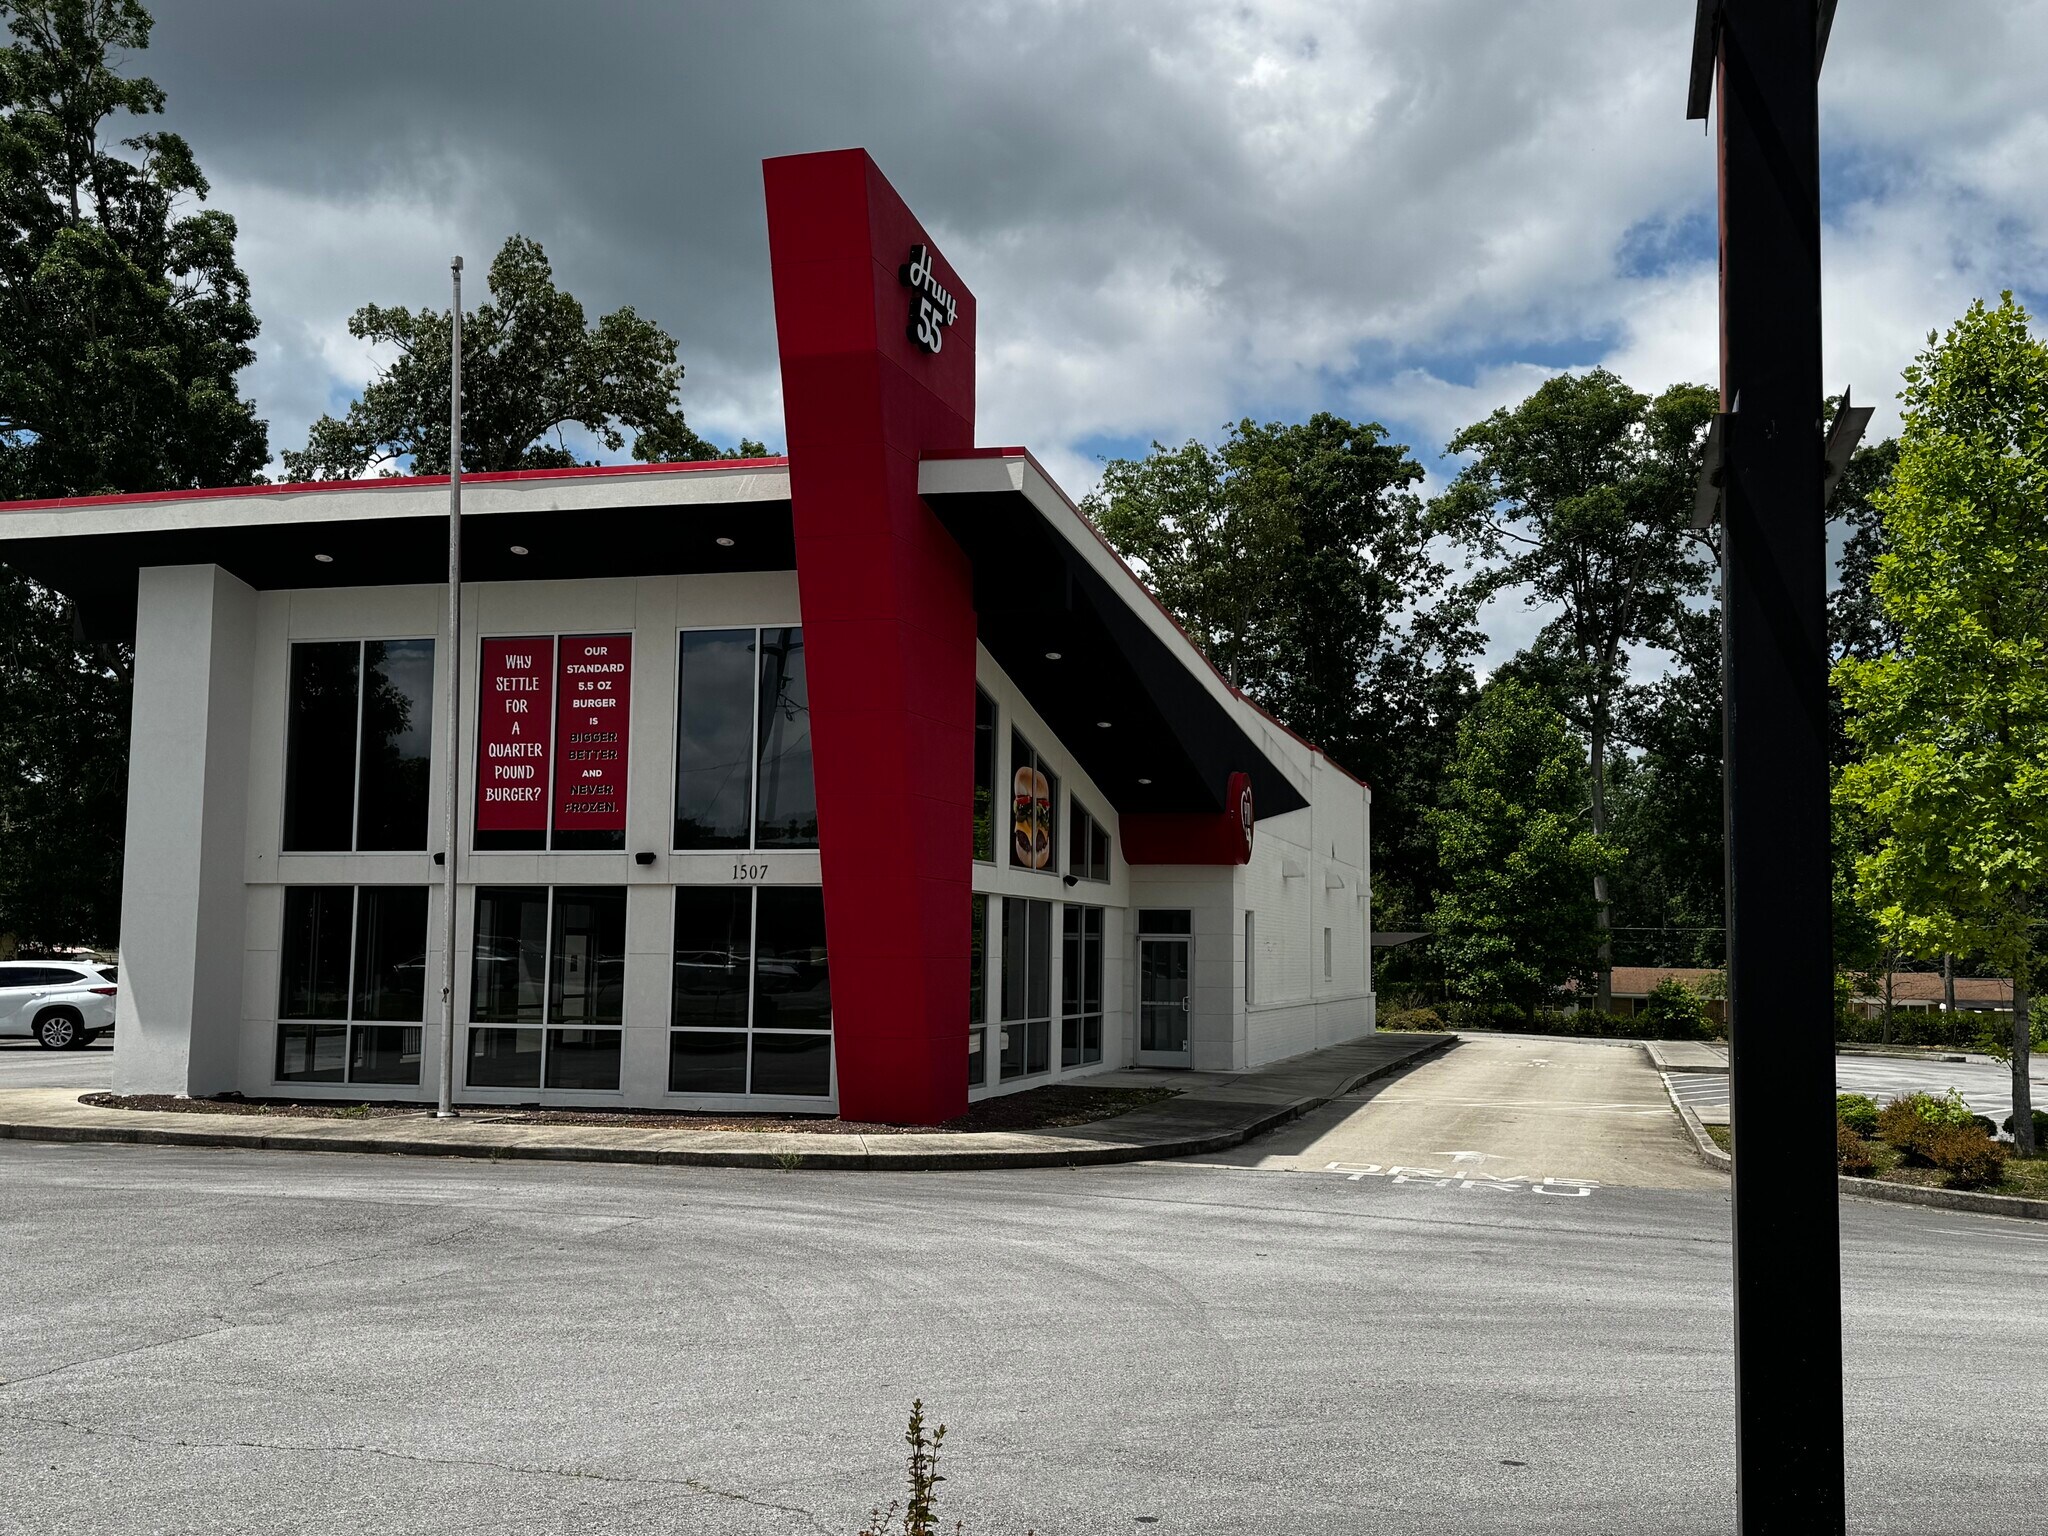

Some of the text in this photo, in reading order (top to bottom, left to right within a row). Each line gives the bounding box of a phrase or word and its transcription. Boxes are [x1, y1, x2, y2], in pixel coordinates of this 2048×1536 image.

[909, 245, 958, 326] Hwy
[917, 296, 943, 354] 55
[584, 646, 608, 656] OUR
[505, 654, 532, 669] WHY
[566, 663, 625, 674] STANDARD
[496, 676, 540, 691] SETTLE
[578, 681, 612, 691] 5.5 OZ
[505, 699, 528, 713] FOR
[572, 698, 616, 708] BURGER
[511, 721, 520, 735] A
[589, 717, 599, 726] IS
[570, 732, 618, 744] BIGGER
[488, 742, 543, 758] QUARTER
[568, 749, 618, 761] BETTER
[494, 765, 535, 779] POUND
[581, 769, 603, 778] AND
[485, 787, 542, 802] BURGER?
[570, 784, 614, 795] NEVER
[564, 802, 619, 813] FROZEN.
[732, 864, 769, 880] 1507
[1324, 1161, 1600, 1188] DRIVE
